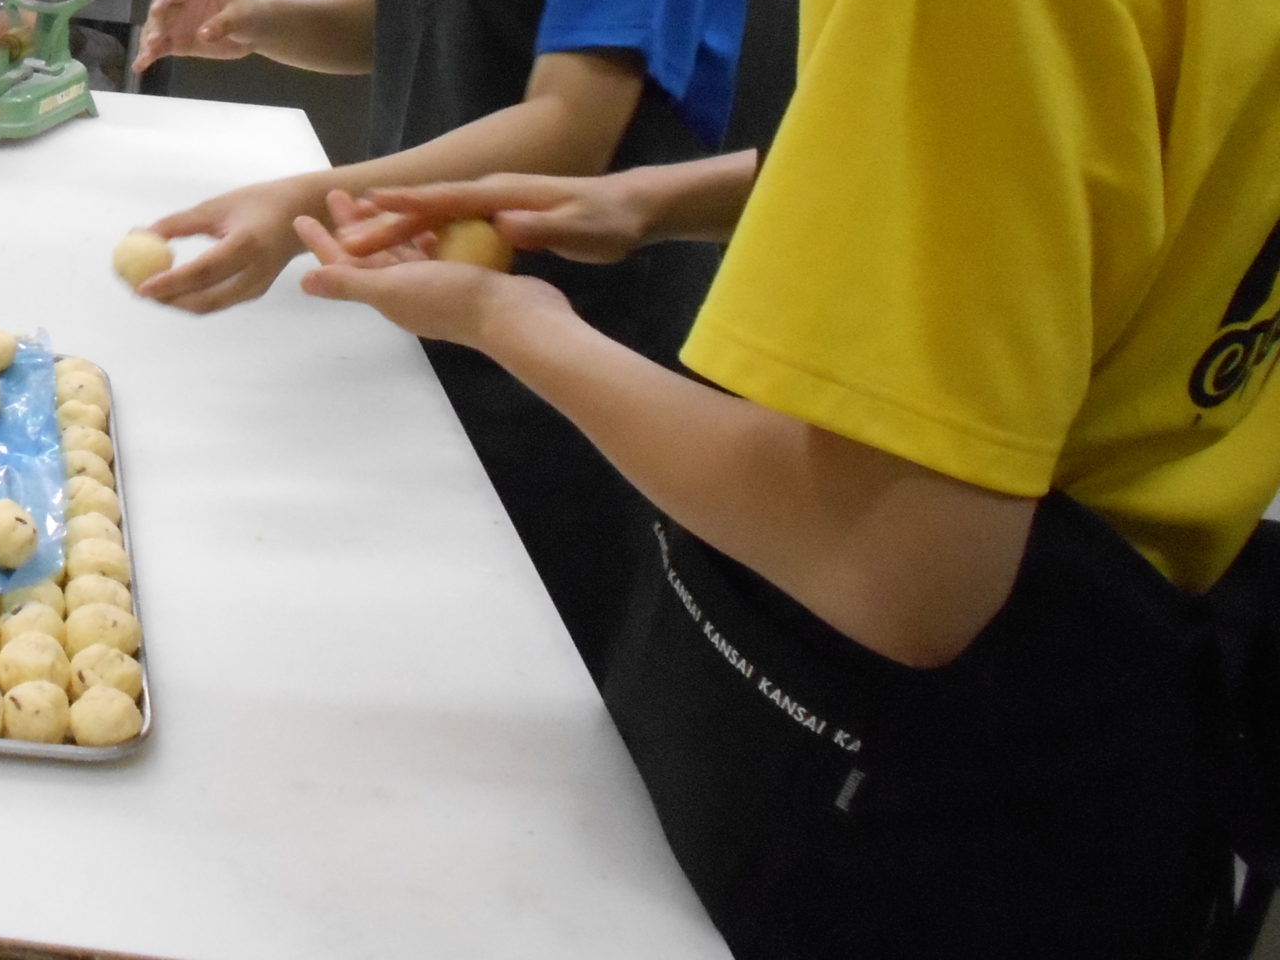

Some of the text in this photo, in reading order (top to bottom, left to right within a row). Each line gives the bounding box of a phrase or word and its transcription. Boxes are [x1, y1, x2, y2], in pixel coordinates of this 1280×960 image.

[667, 568, 701, 622] KANSAI
[703, 621, 754, 678] KANSAI
[758, 676, 827, 734] KANSAI
